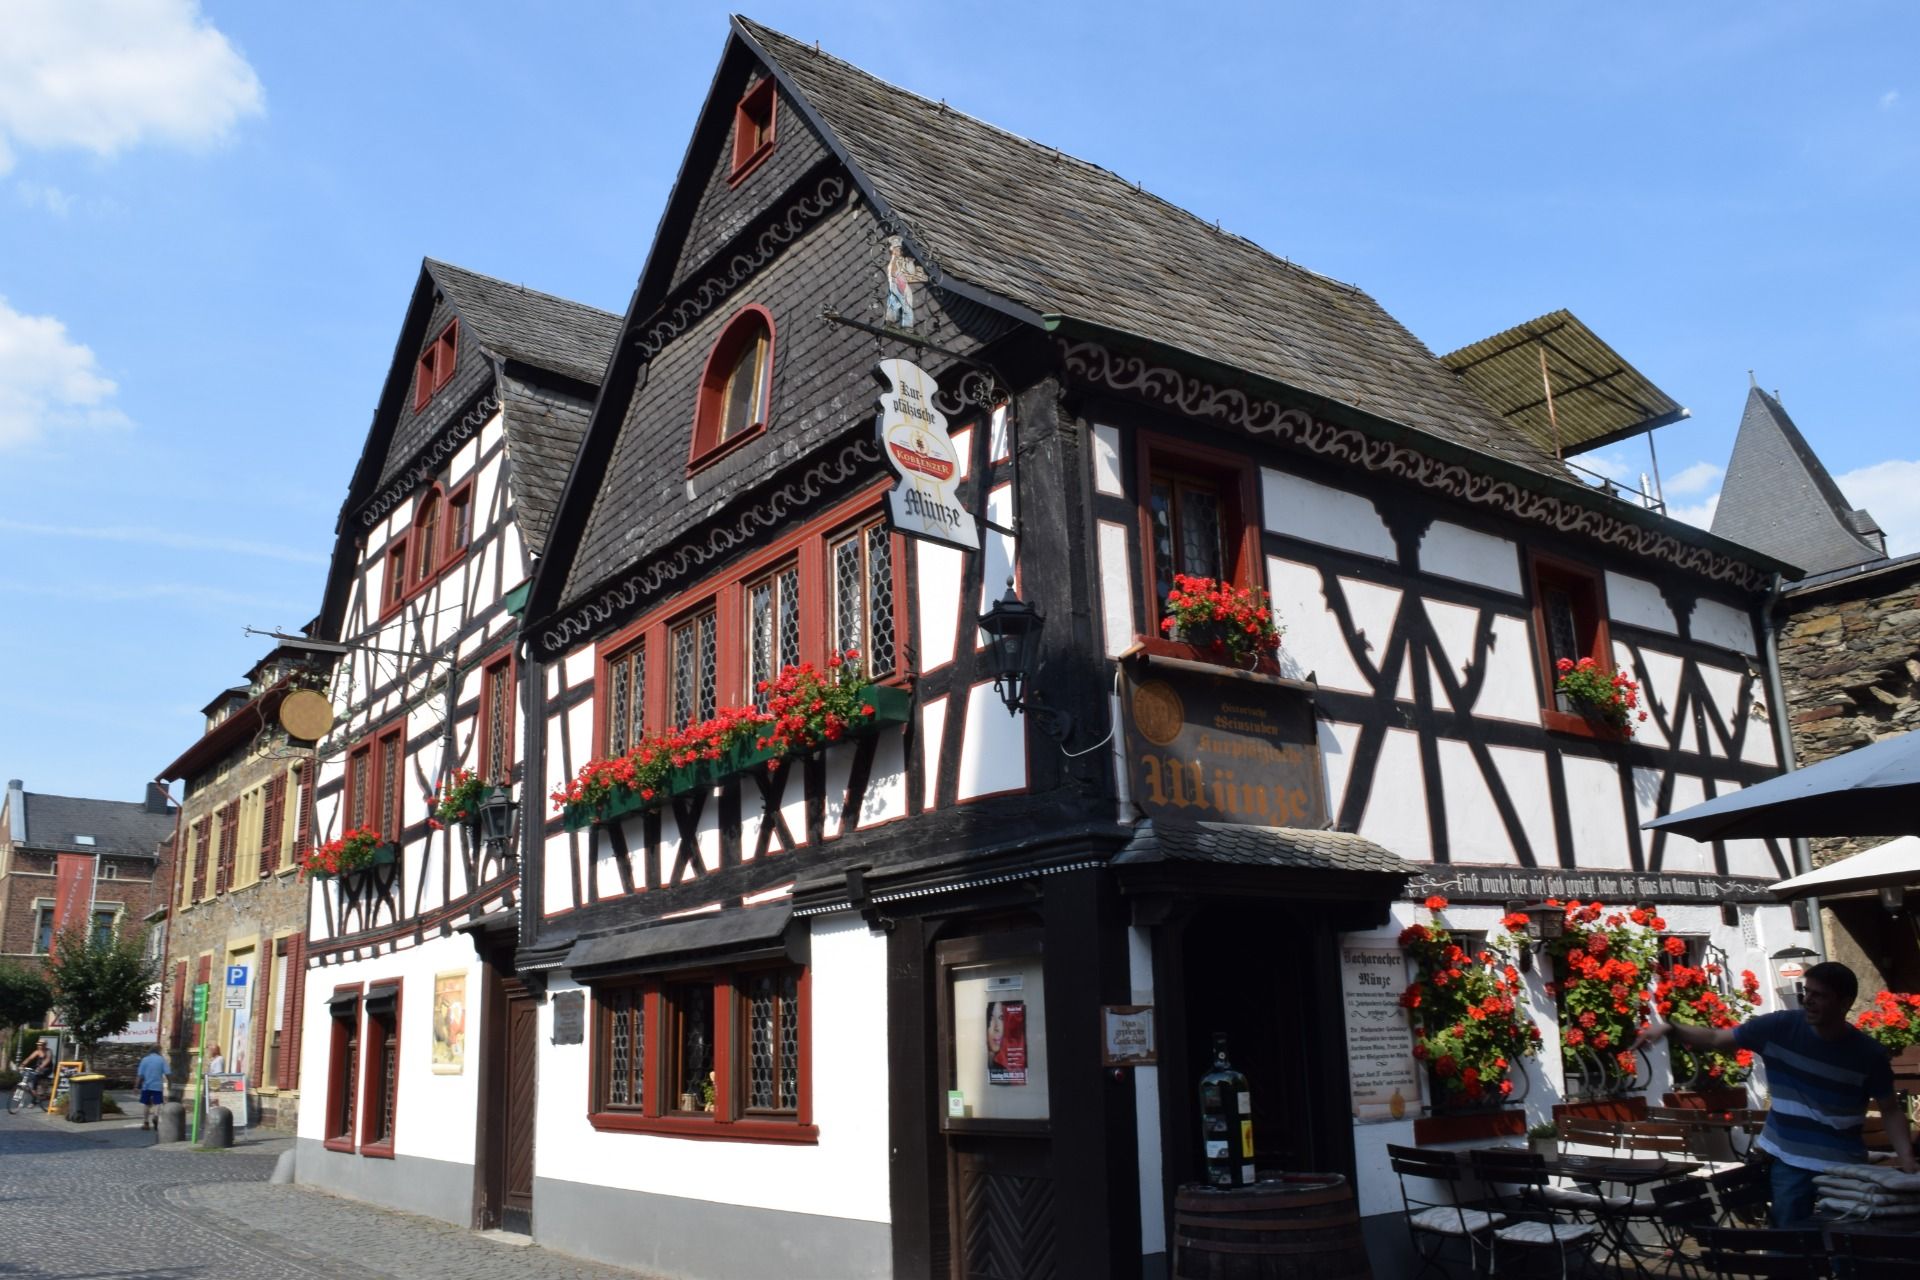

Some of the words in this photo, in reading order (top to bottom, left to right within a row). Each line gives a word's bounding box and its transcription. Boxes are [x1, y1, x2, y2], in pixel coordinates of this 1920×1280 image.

[899, 380, 923, 400] Kur-
[892, 397, 936, 424] pfälzische
[904, 487, 961, 529] Münze
[1214, 715, 1279, 735] Weinstuben
[1141, 754, 1309, 825] Münze
[1481, 874, 1509, 893] wurde
[1509, 873, 1528, 896] hier
[1530, 875, 1546, 894] viel
[1344, 951, 1401, 968] Bacharacher
[231, 969, 243, 984] P
[1358, 972, 1391, 989] Münze
